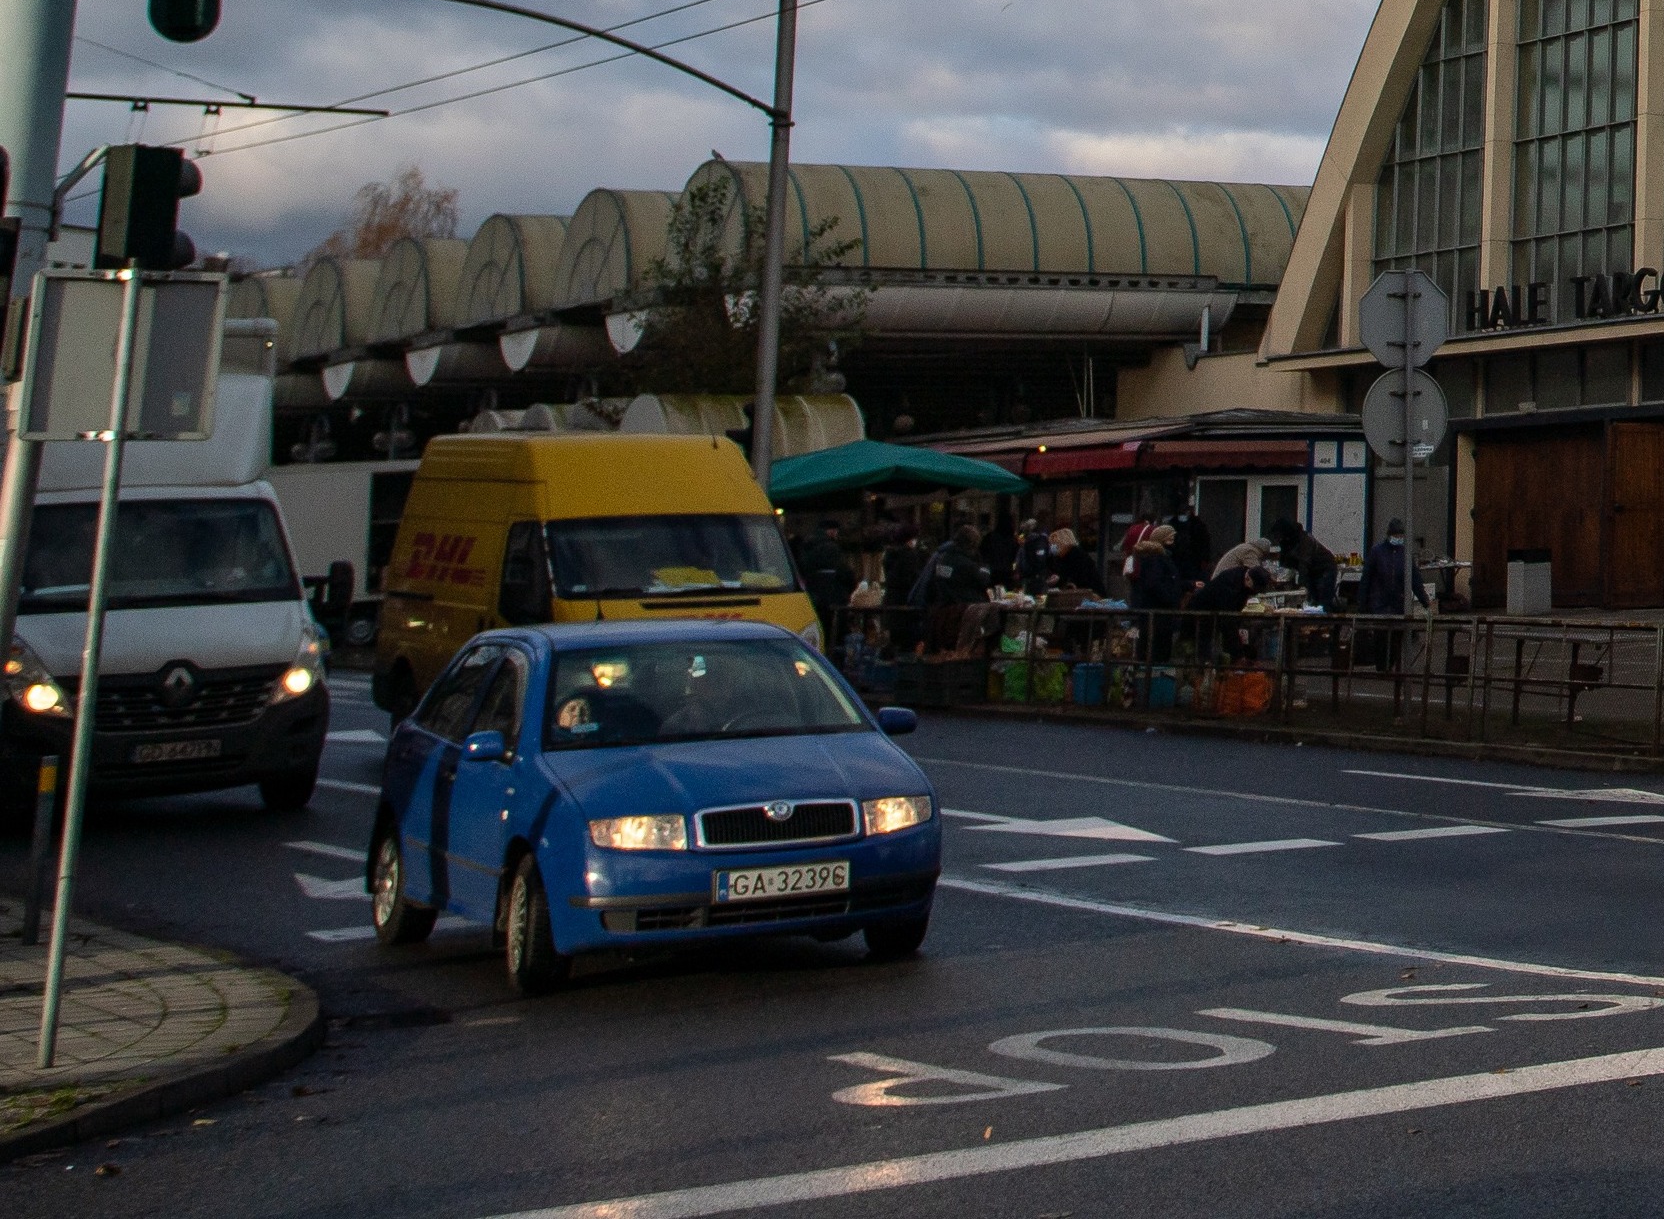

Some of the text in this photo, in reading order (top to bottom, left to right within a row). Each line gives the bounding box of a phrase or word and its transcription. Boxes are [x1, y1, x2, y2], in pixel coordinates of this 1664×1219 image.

[1465, 281, 1547, 332] HALE
[733, 865, 846, 895] GA 32396
